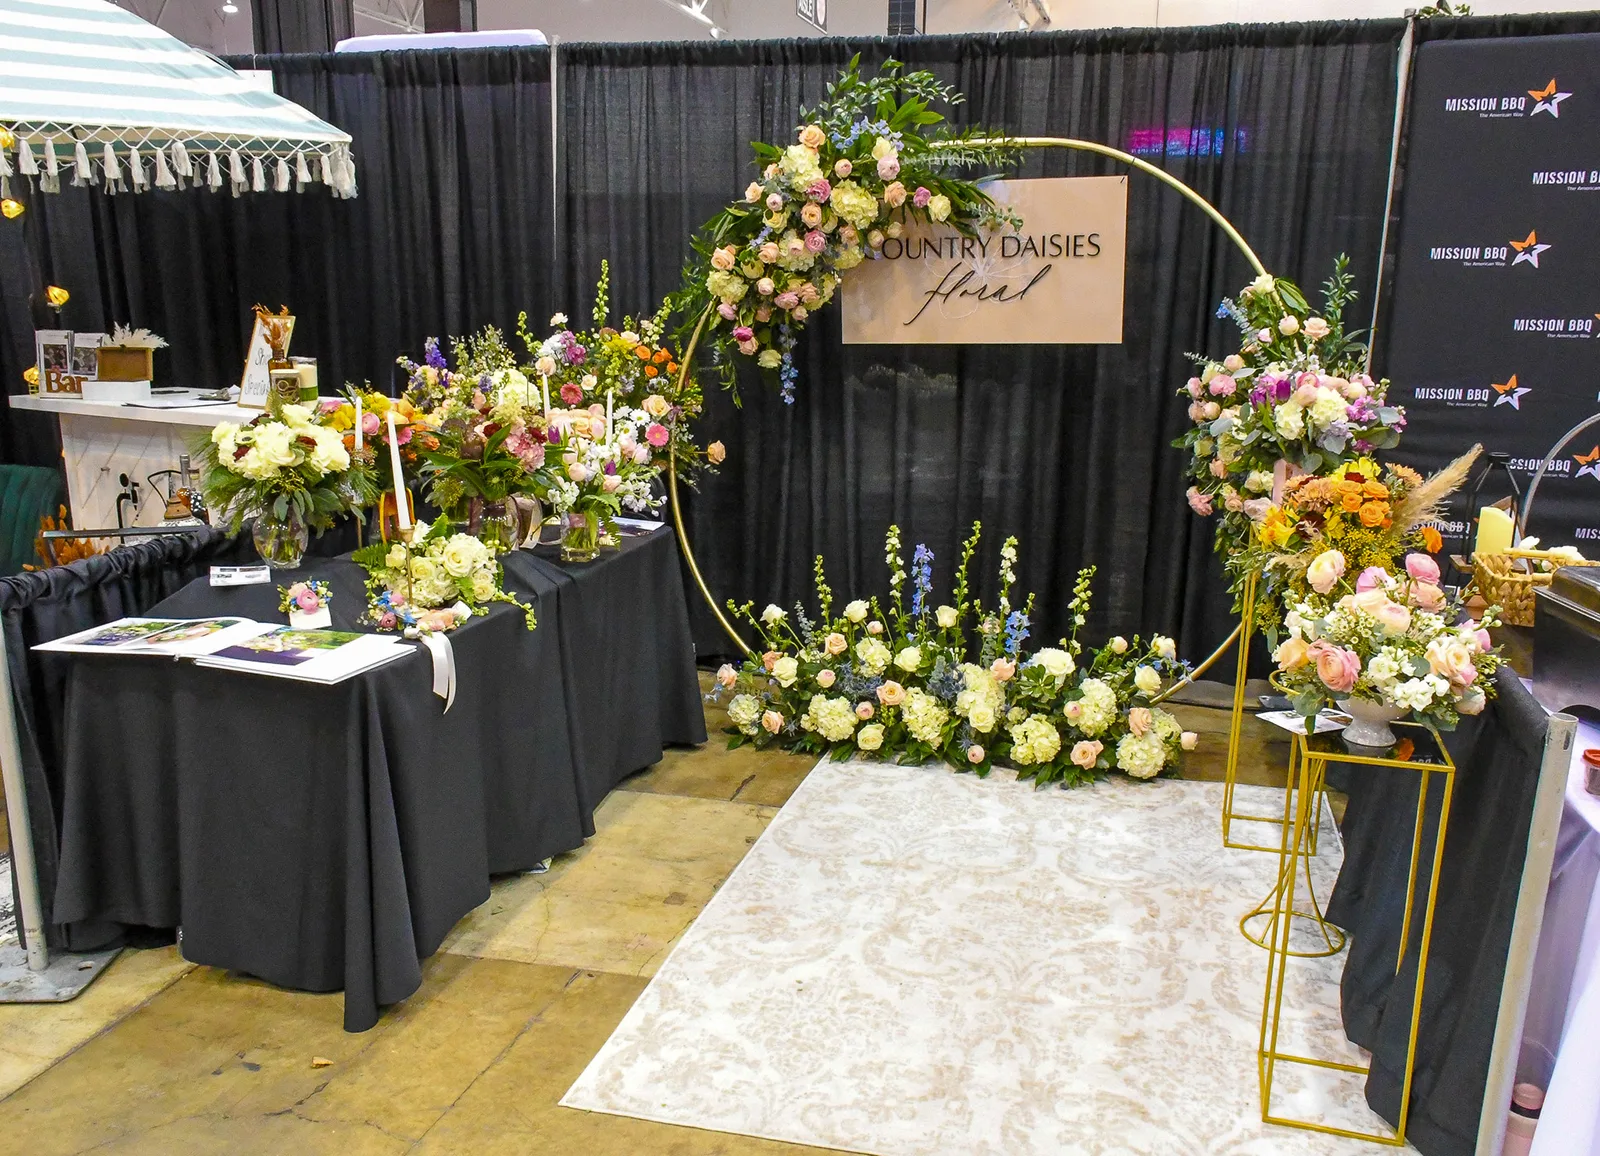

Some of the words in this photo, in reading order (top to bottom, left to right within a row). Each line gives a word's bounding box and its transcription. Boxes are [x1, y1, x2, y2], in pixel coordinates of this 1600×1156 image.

[1445, 97, 1497, 111] MISSION
[1501, 96, 1526, 111] BBQ
[1532, 170, 1586, 185] MISSION
[1589, 170, 1600, 184] B
[1001, 233, 1101, 258] DAISIES
[1430, 247, 1480, 260] MISSION
[1484, 246, 1508, 261] BBQ
[903, 261, 1053, 327] floral
[1513, 319, 1565, 331] MISSION
[1568, 319, 1593, 333] BBQ
[45, 367, 89, 393] Bar
[1414, 387, 1464, 400] MISSION
[1467, 388, 1490, 402] BBQ
[1509, 458, 1544, 470] SSION
[1548, 459, 1571, 473] BBQ
